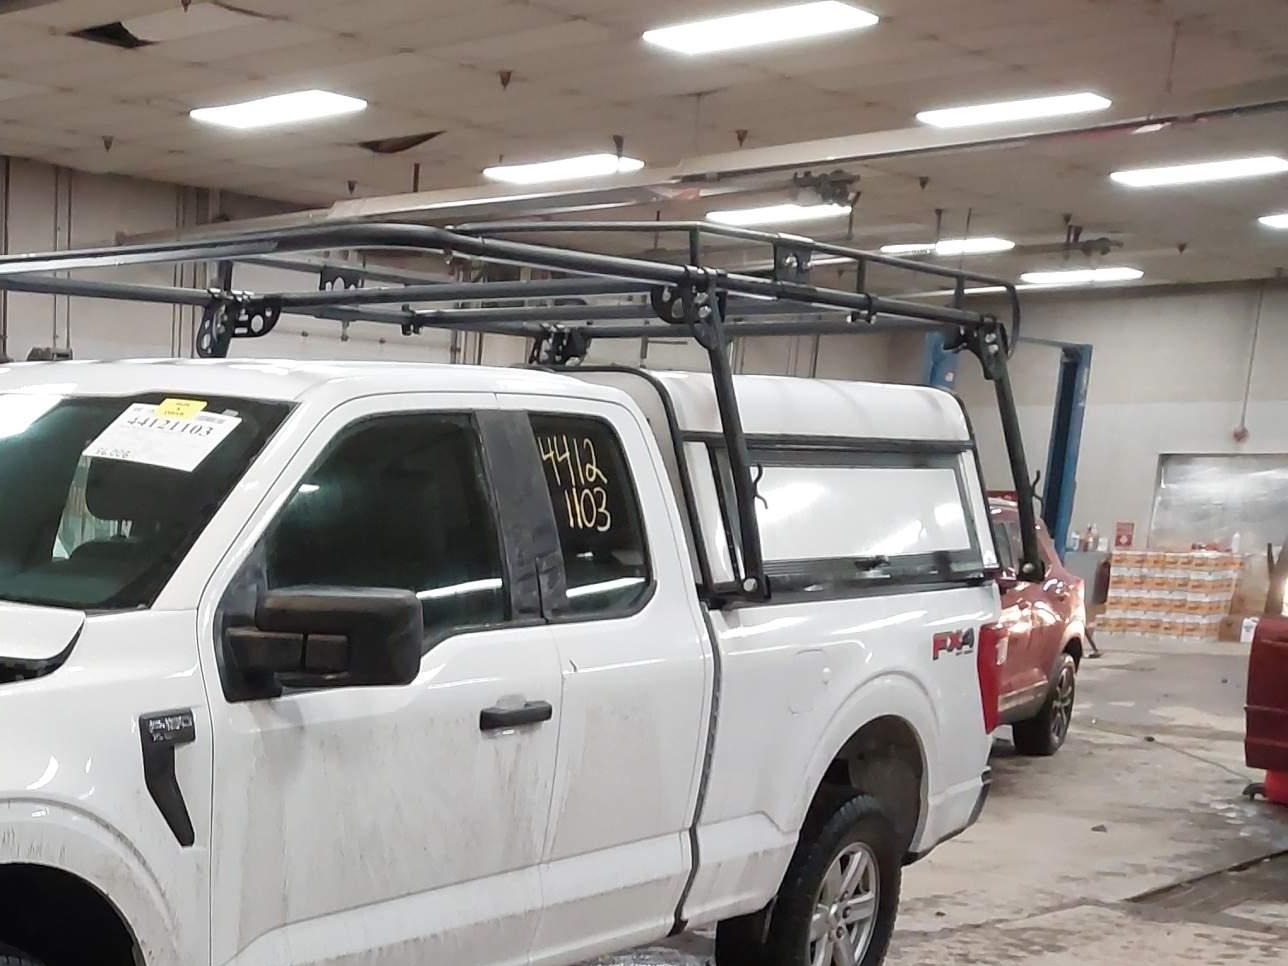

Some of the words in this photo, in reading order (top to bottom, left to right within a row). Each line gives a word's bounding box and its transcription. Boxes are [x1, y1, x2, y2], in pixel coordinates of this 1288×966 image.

[127, 416, 214, 437] 44121103
[537, 434, 608, 486] 4412
[564, 486, 612, 532] 1103
[932, 627, 975, 661] FX4
